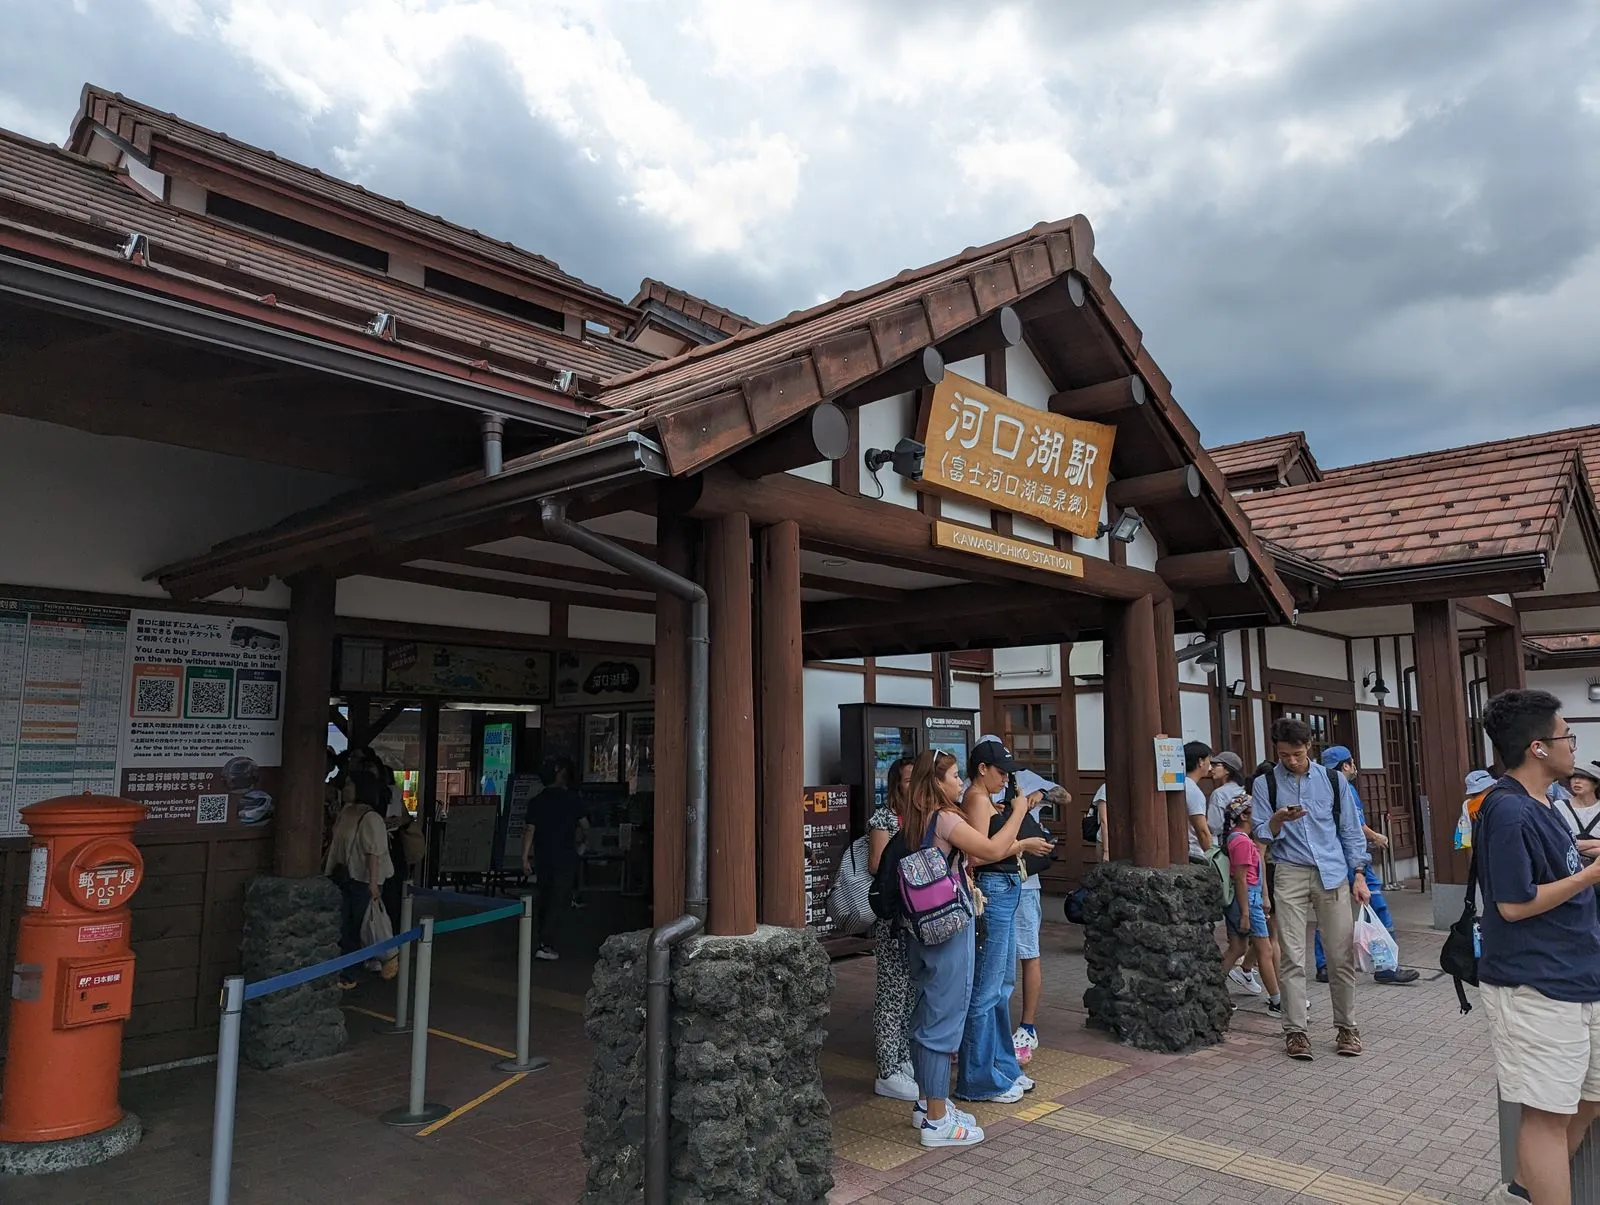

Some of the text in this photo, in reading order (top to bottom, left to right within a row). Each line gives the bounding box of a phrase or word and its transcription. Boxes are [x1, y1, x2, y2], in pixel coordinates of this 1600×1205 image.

[945, 391, 1098, 489] 河口湖駅
[952, 531, 1072, 572] KAWAGUCHIKO STATION
[191, 650, 241, 659] Expressway
[86, 885, 126, 899] POST
[94, 974, 120, 984] 日本郵便
